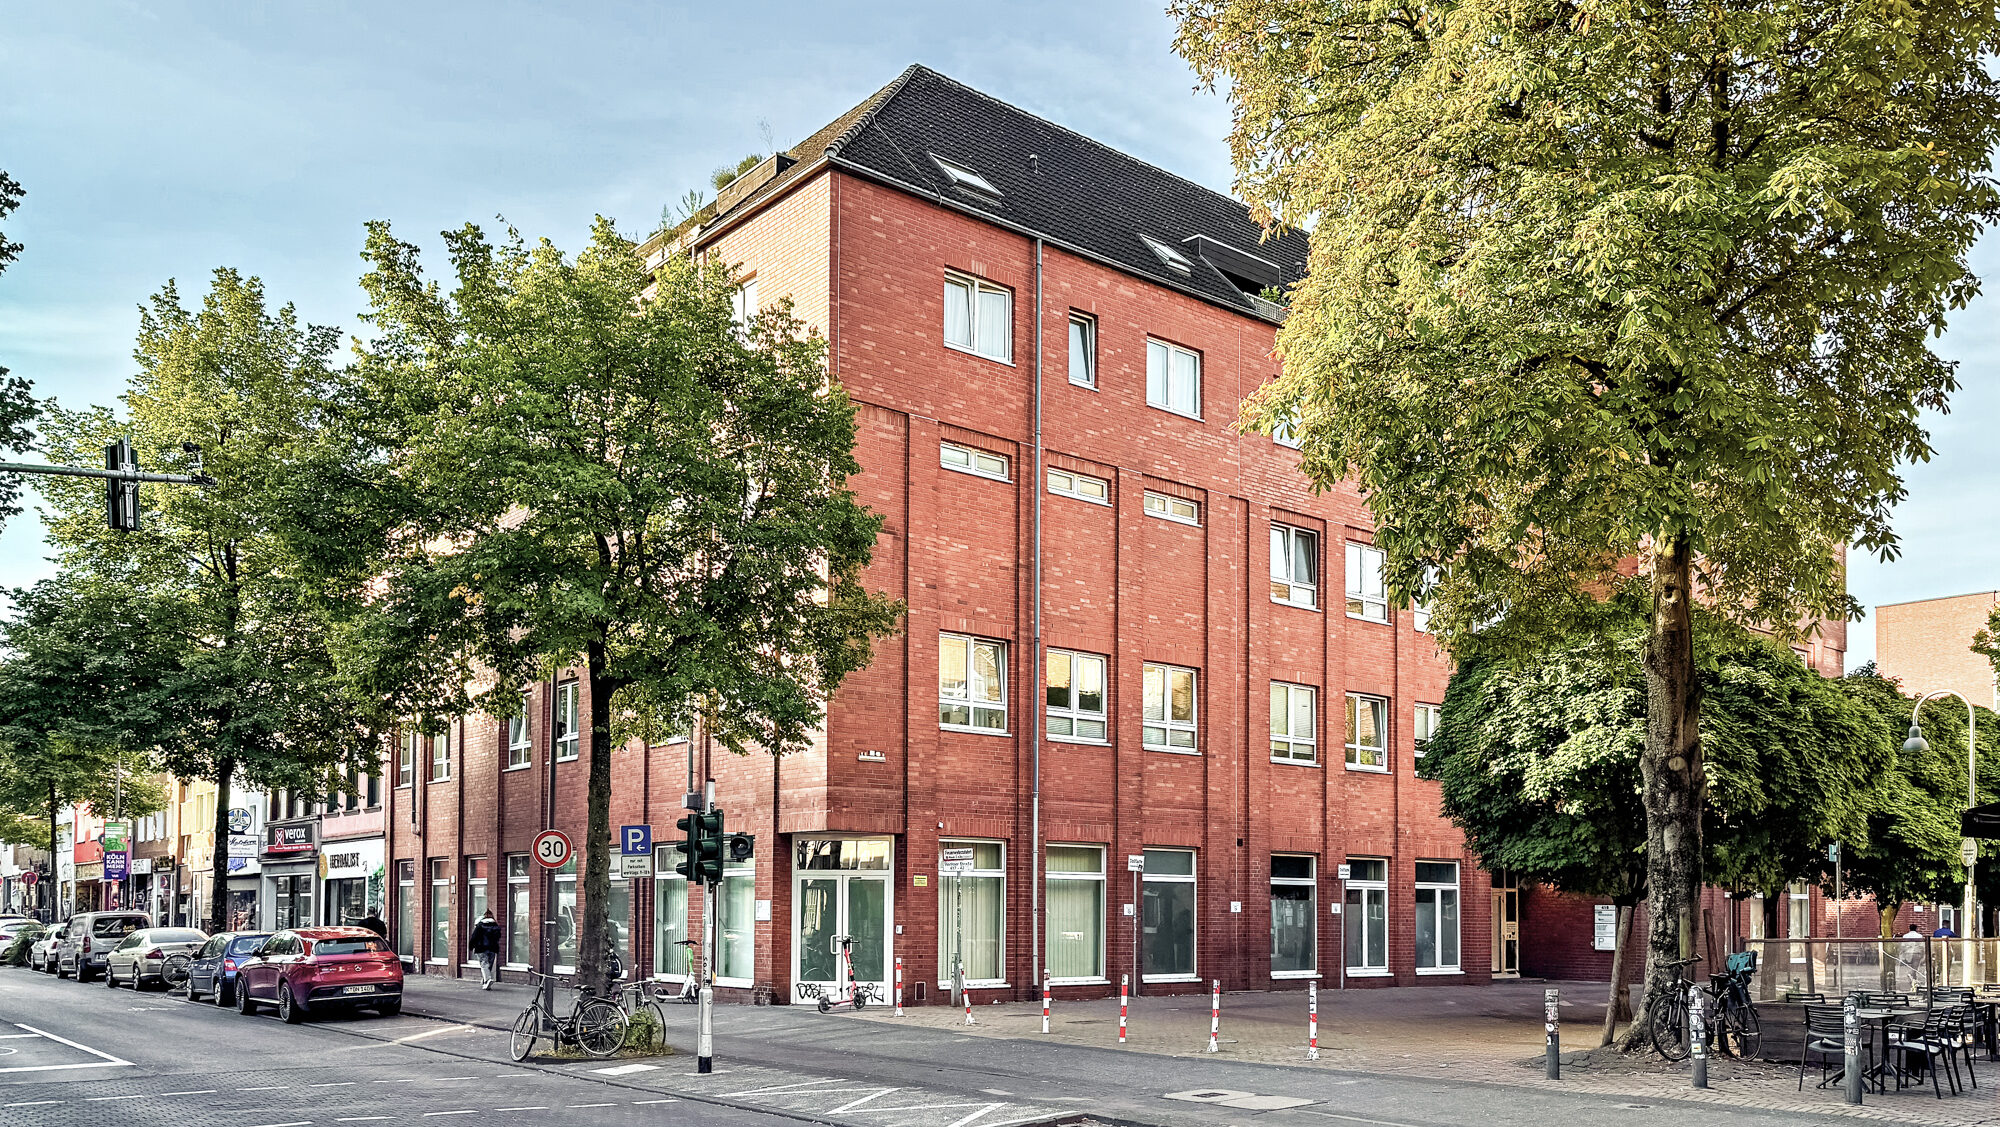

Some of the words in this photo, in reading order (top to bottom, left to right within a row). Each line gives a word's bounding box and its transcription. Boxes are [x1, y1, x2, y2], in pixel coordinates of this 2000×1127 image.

[284, 828, 306, 839] verox
[627, 829, 644, 851] P
[541, 841, 563, 857] 30
